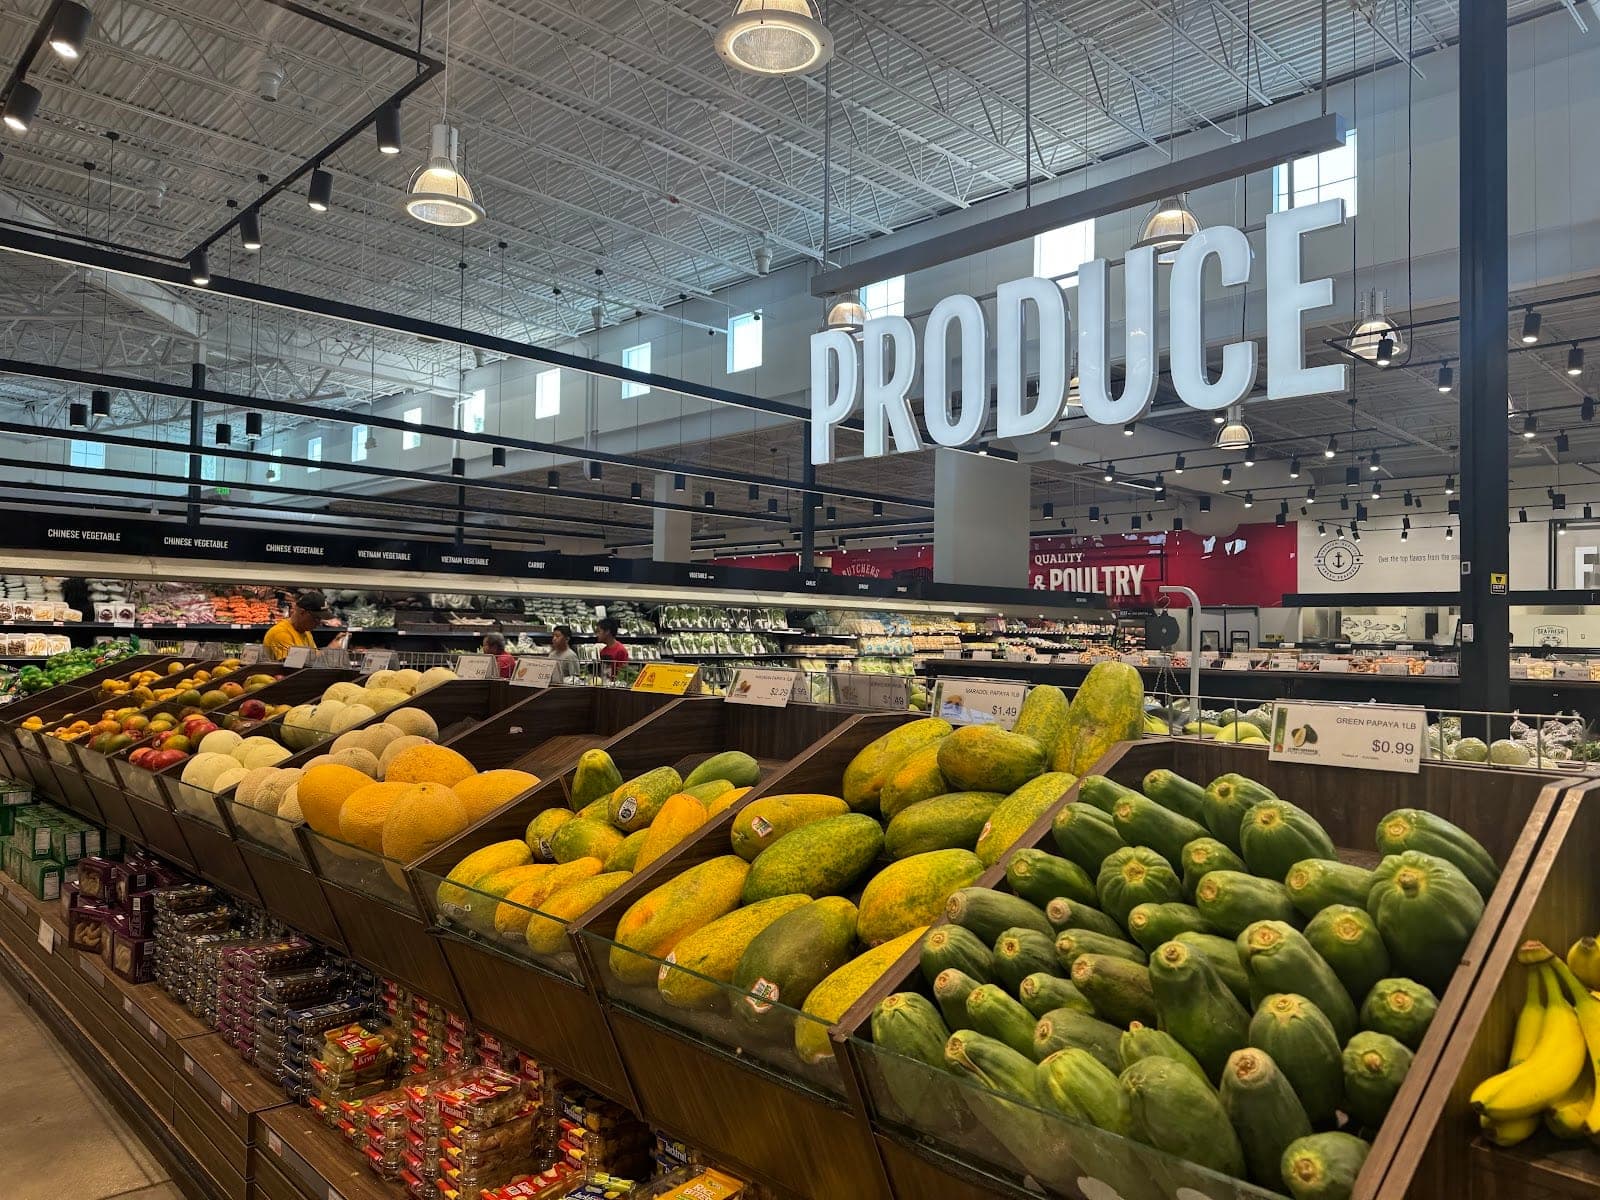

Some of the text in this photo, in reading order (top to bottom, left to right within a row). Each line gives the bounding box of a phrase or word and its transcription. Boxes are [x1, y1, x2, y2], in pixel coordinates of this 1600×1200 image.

[810, 198, 1349, 465] PRODUCE
[47, 528, 121, 542] CHINESE VEGETABLE
[164, 536, 229, 549] CHINESE VEGETABLE
[265, 543, 324, 556] CHINESE VEGETABLE
[357, 549, 412, 561] VIETNAM VEGETABLE
[440, 555, 463, 564] VIETNAM
[1034, 552, 1083, 566] QUALITY
[1033, 564, 1145, 597] & POULTRY
[991, 704, 1017, 717] $1.49
[1336, 717, 1417, 731] GREEN PAPAYA 1LB
[1371, 738, 1414, 756] $0.99
